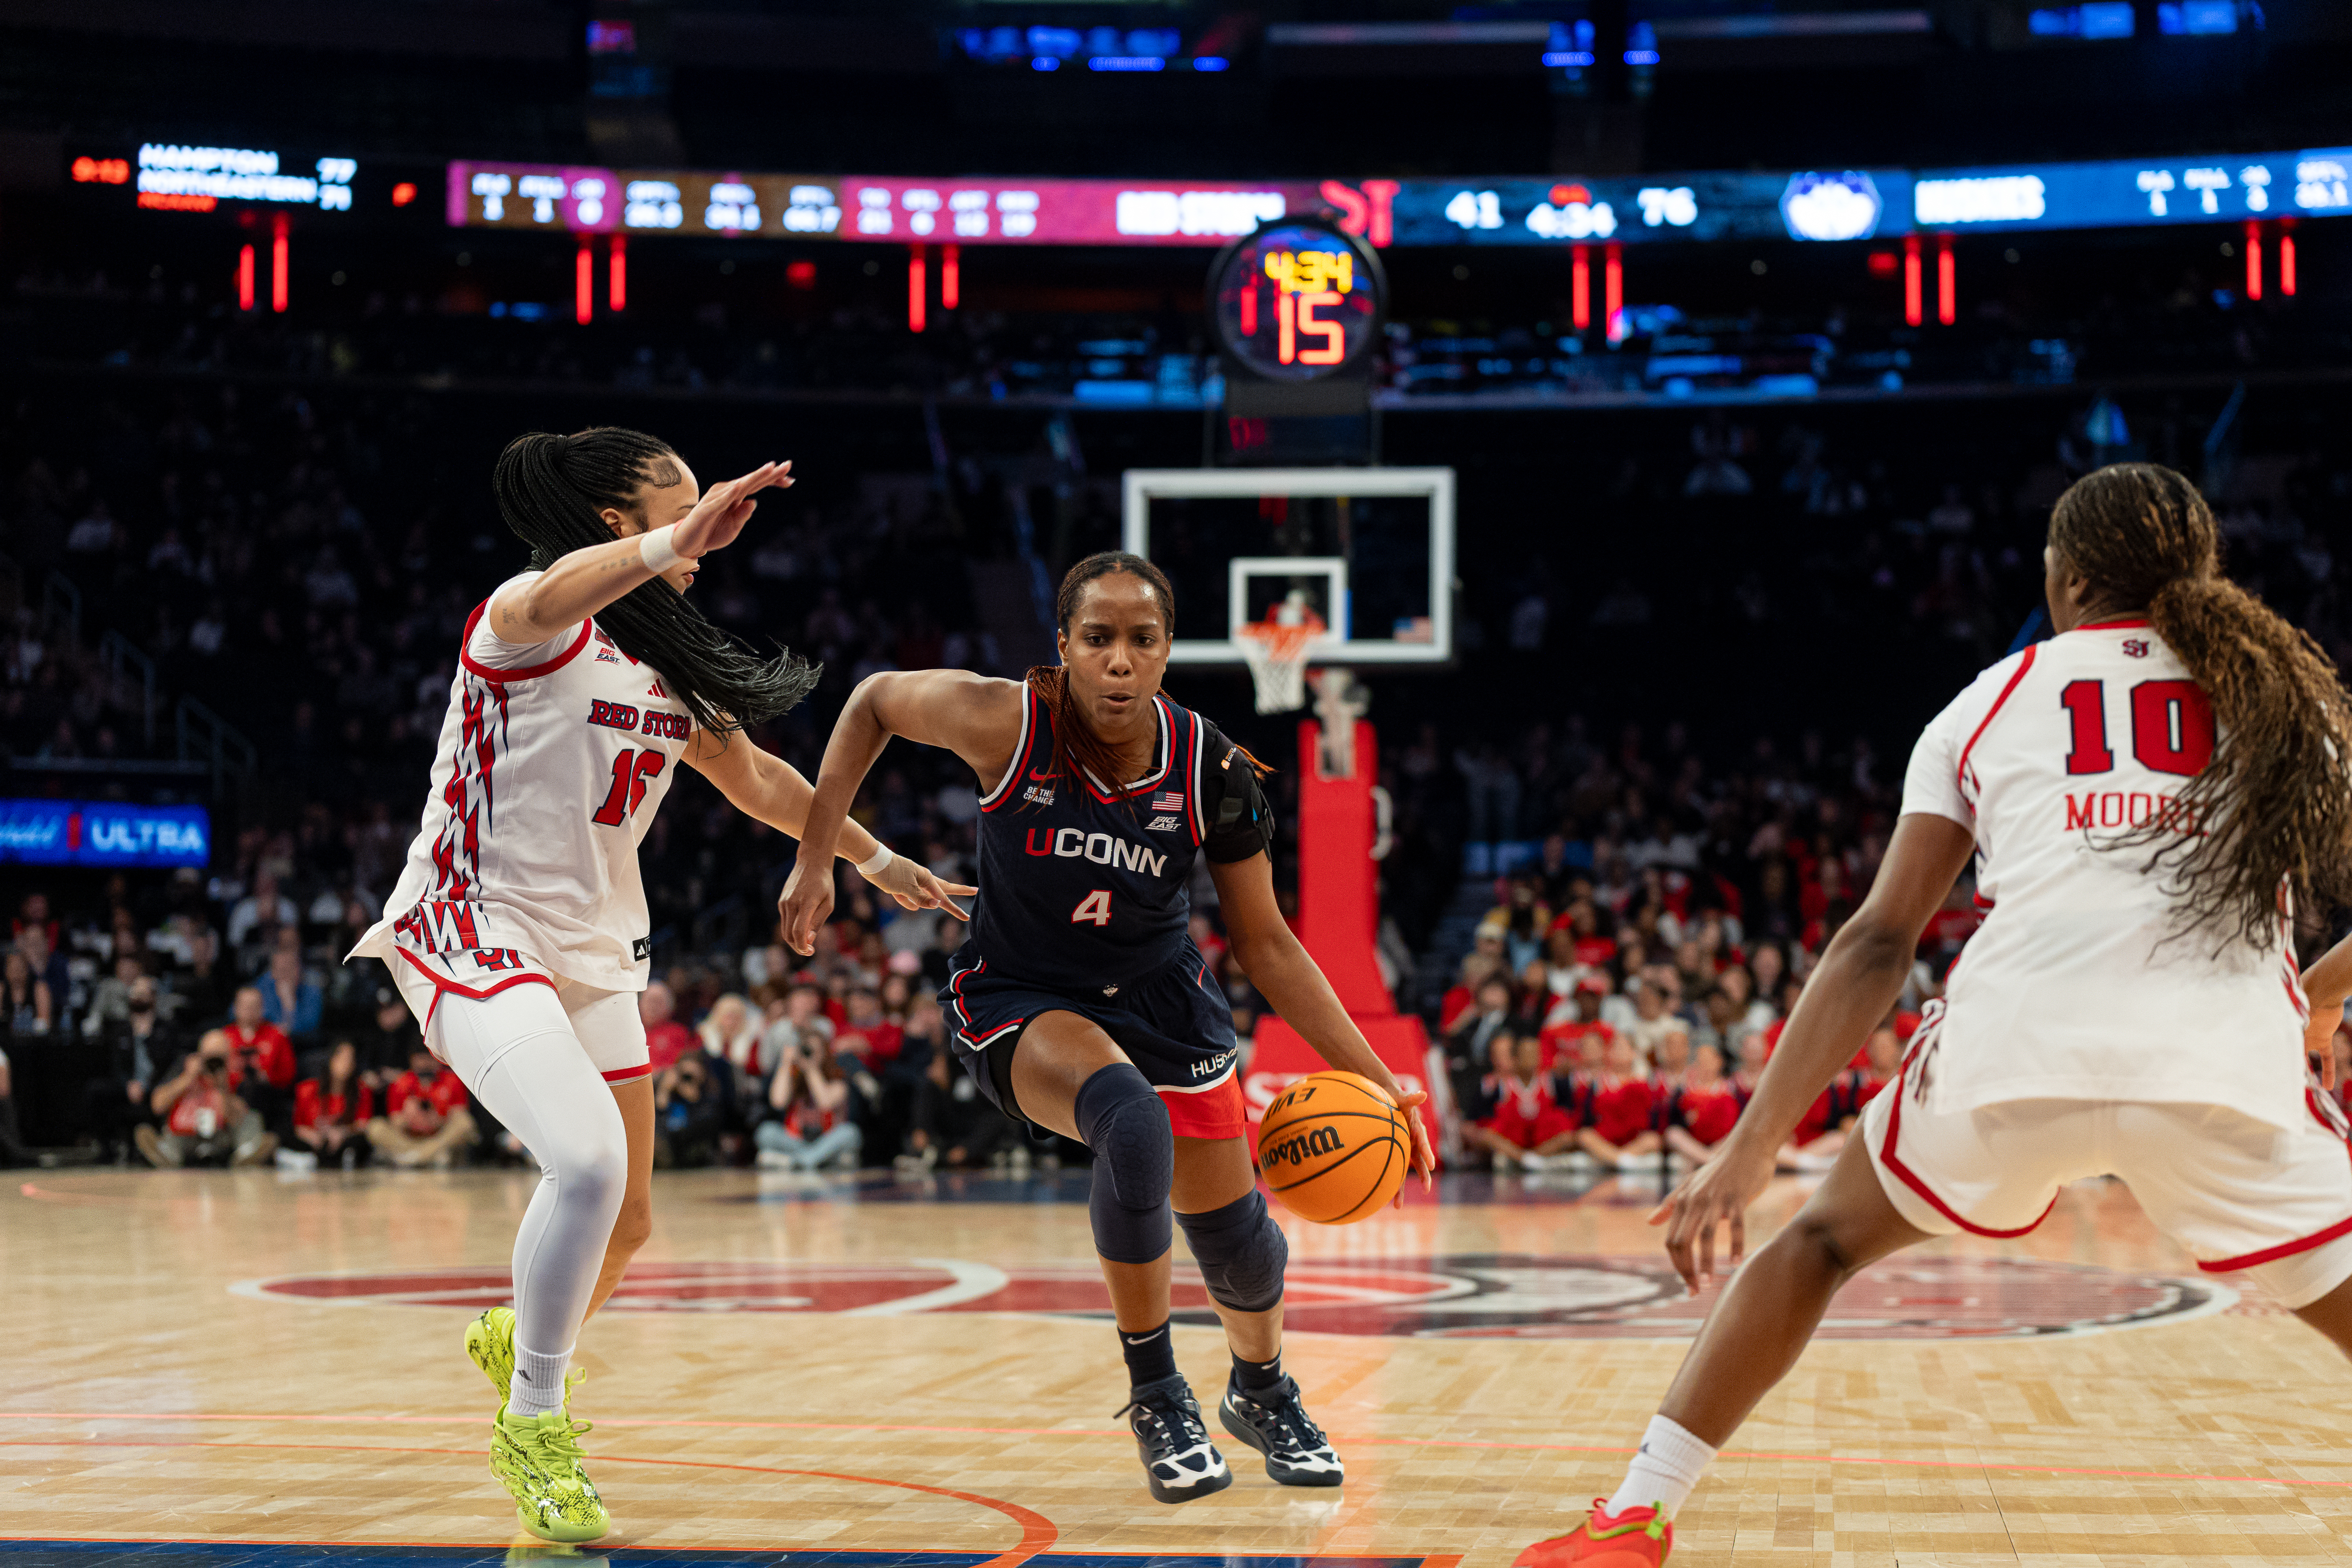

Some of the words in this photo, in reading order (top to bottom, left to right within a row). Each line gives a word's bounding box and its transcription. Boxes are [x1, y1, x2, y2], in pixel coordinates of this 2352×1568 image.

[1445, 191, 1503, 229] 41
[1637, 186, 1698, 226] 76
[1279, 291, 1345, 365] 15
[596, 653, 620, 663] EAST
[600, 647, 615, 656] BIG
[587, 699, 639, 731] RED
[2060, 679, 2215, 778] 10
[591, 748, 666, 827] 16
[1023, 793, 1054, 805] CHANGE
[1027, 786, 1038, 795] BE
[91, 817, 207, 855] ULTRA
[1025, 828, 1167, 877] UCONN
[1071, 890, 1112, 926] 4
[1260, 1125, 1345, 1172] Wilson
